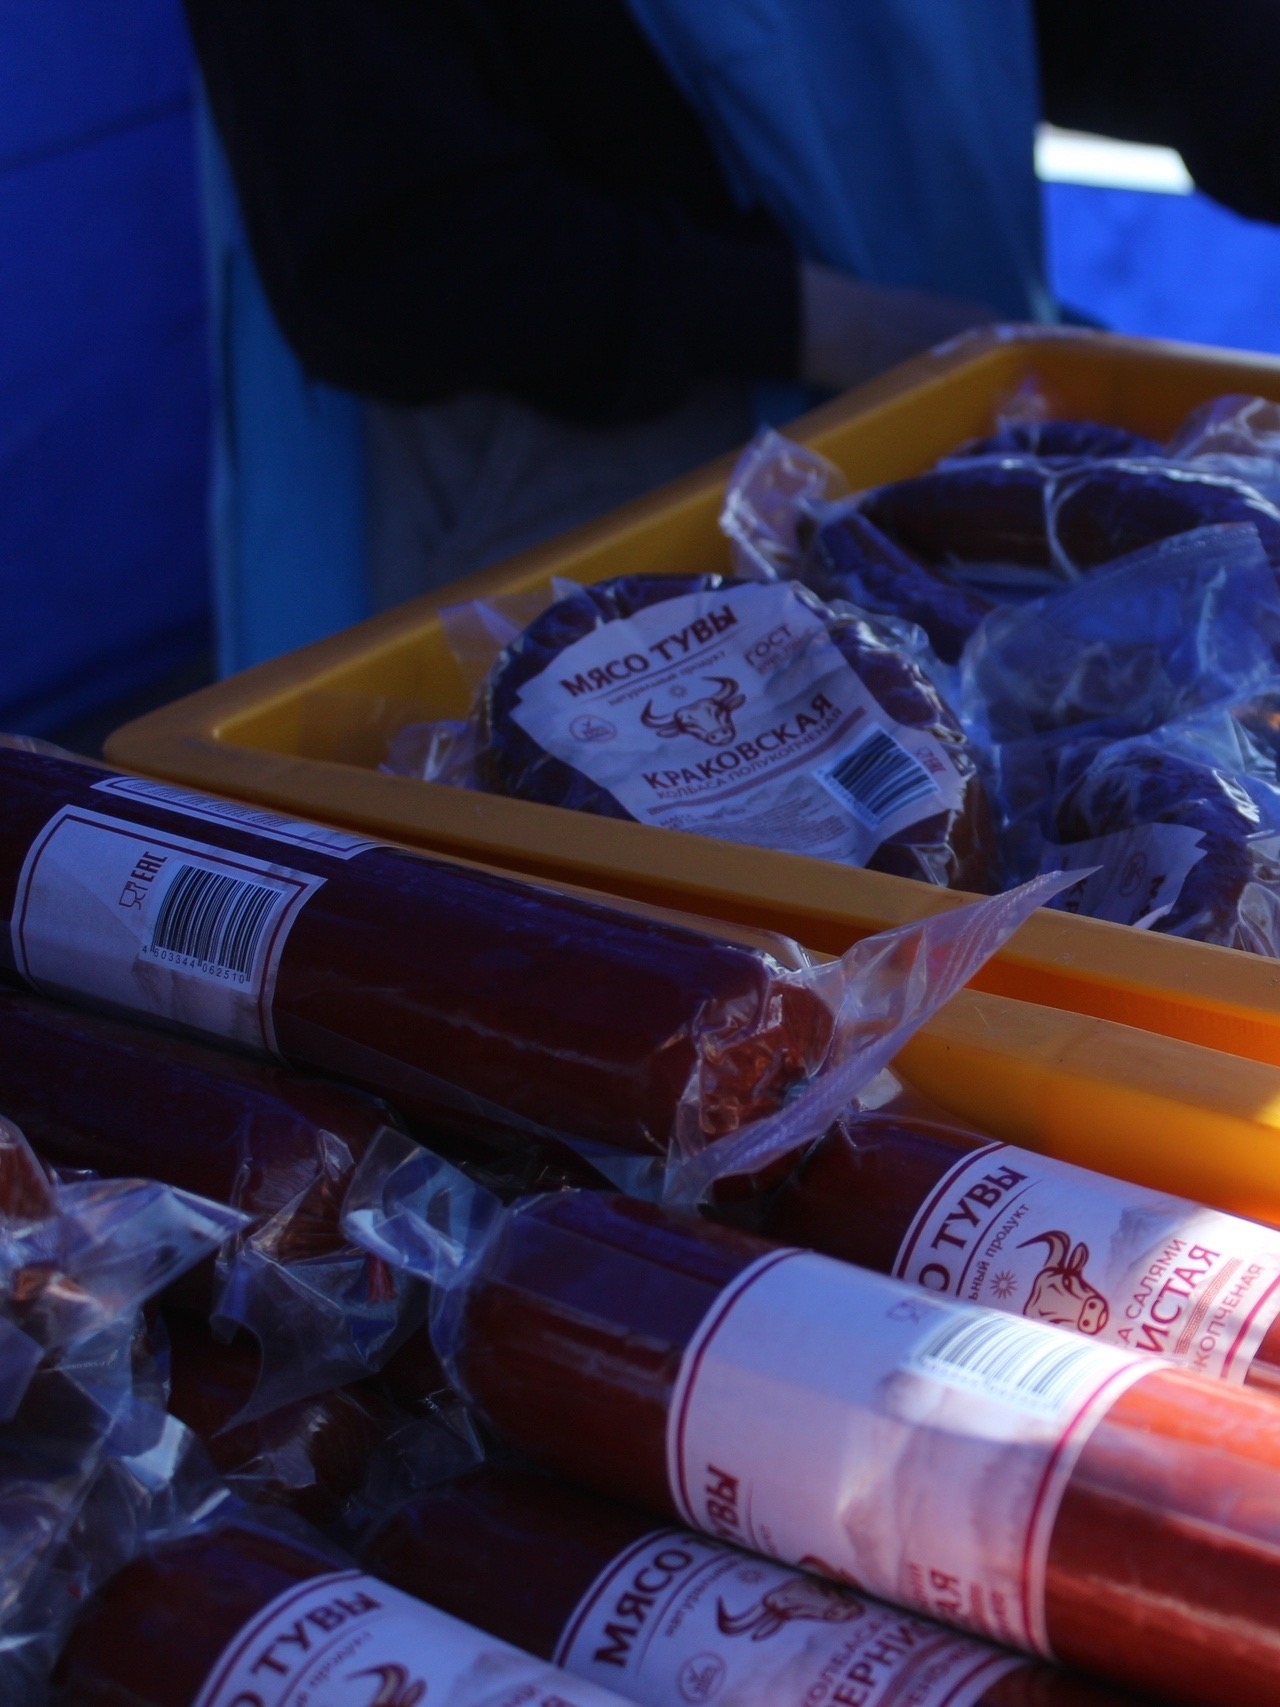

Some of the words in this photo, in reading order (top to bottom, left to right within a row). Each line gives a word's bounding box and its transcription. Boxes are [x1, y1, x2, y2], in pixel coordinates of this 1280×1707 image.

[559, 653, 651, 697] МЯСО
[649, 603, 738, 662] ТУВЫ
[744, 623, 792, 667] ГОСТ
[642, 692, 834, 790] КРАКОВСКАЯ
[656, 776, 728, 799] КОЛБАСА
[727, 706, 844, 779] ПОЛУКОПЧЕНАЯ
[930, 1165, 1029, 1251] ТУВЫ
[985, 1203, 1031, 1258] продукт
[1126, 1238, 1187, 1319] САЛЯМИ
[1136, 1244, 1221, 1353] ИСТАЯ
[1194, 1263, 1265, 1368] КОПЧЕНАЯ
[251, 1591, 384, 1677] ТУВЫ
[593, 1549, 694, 1669] МЯСО
